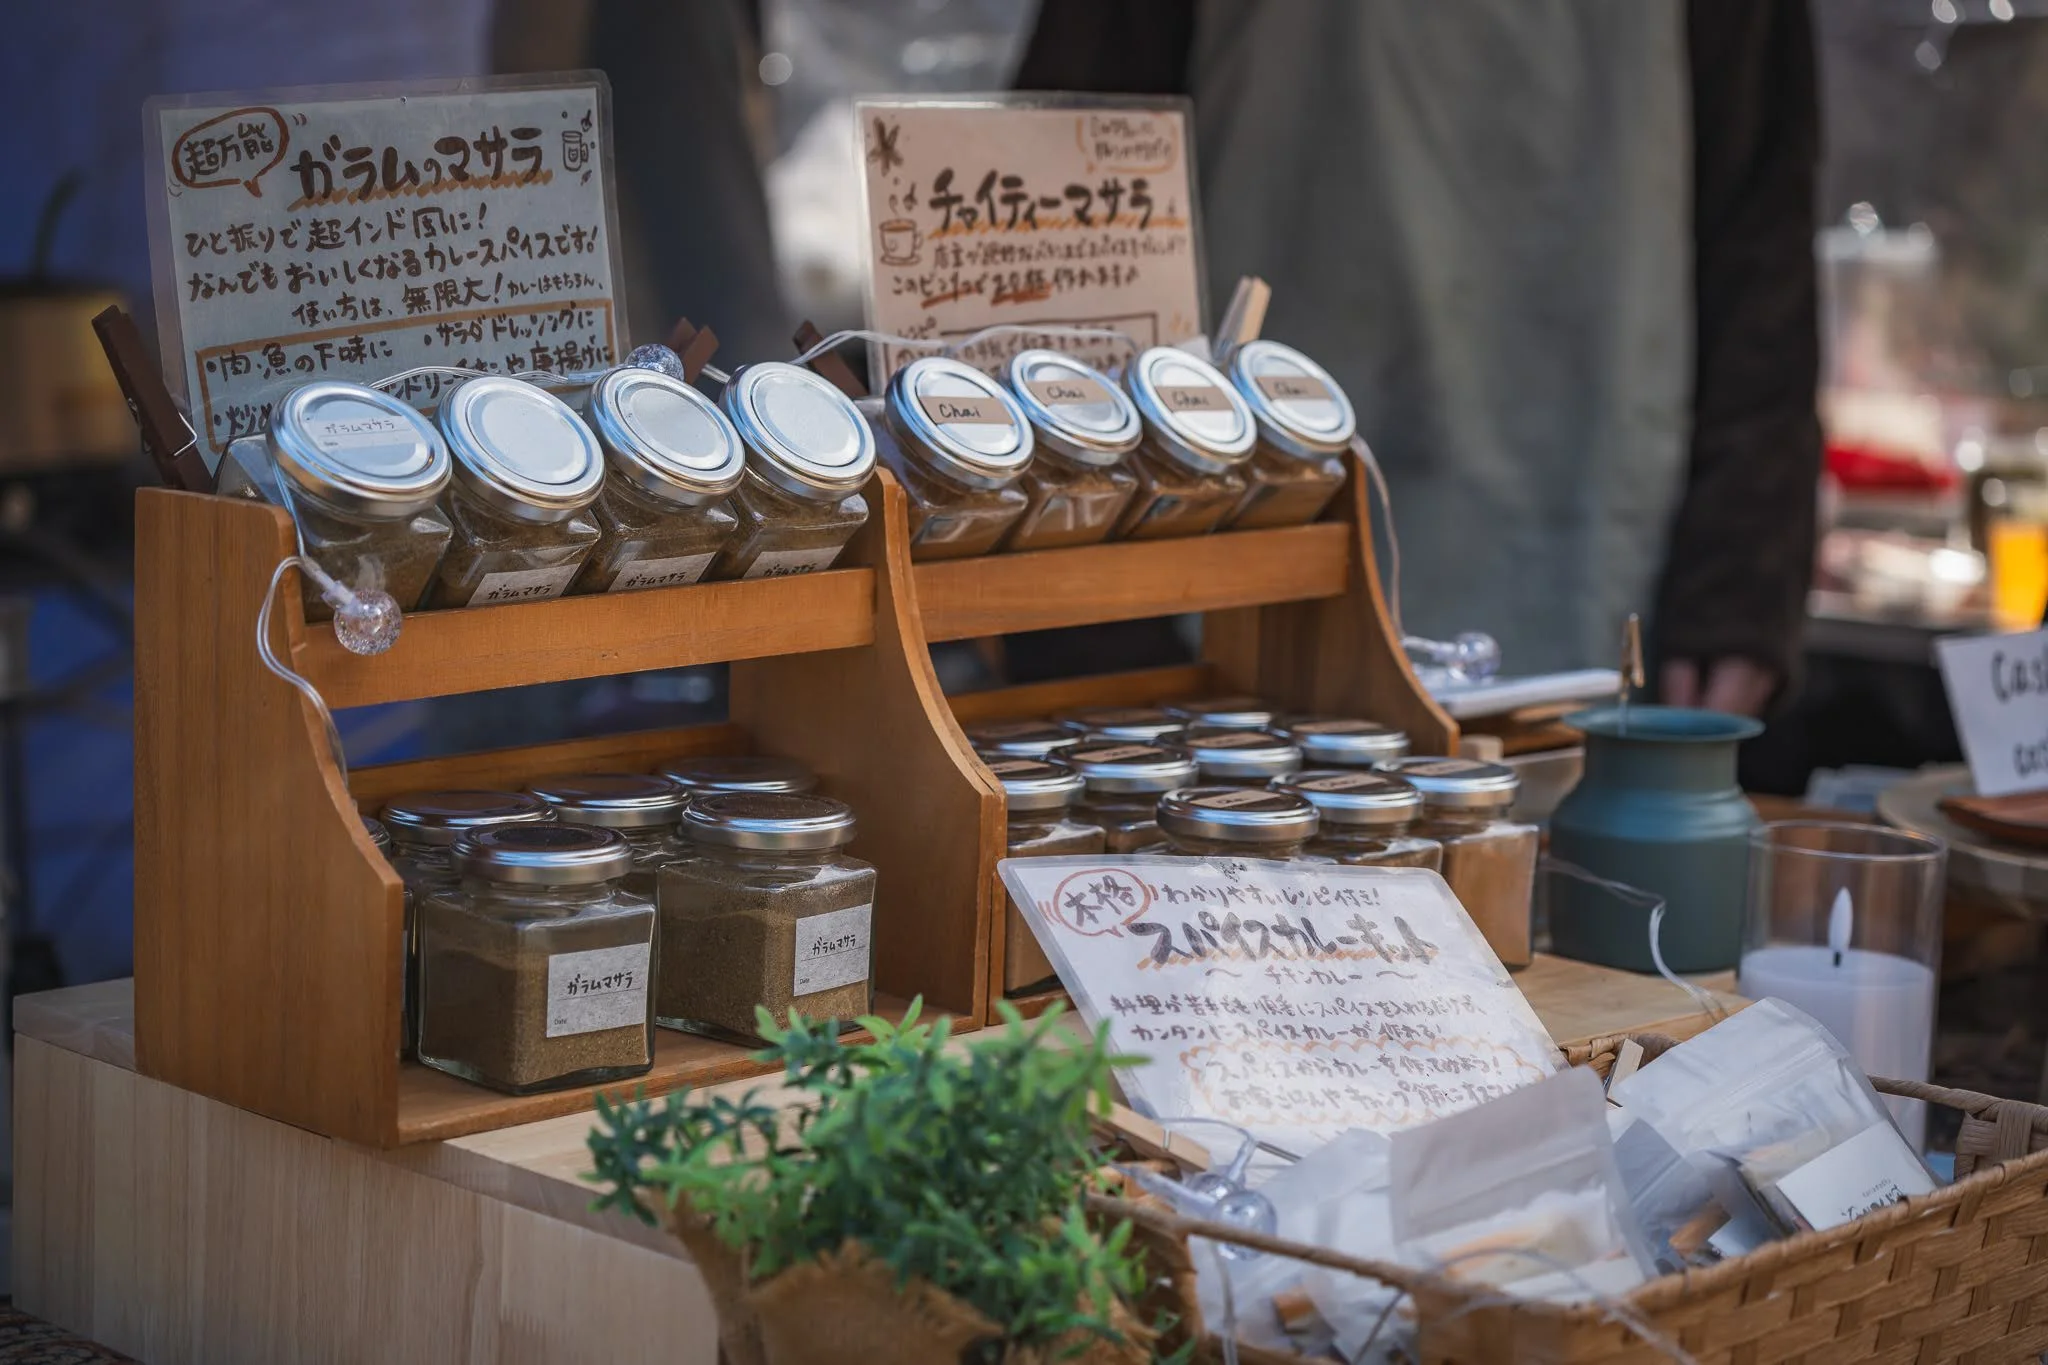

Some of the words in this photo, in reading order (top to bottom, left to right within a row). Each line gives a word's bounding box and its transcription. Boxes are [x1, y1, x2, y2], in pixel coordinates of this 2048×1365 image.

[184, 123, 274, 182] 超万能
[290, 126, 543, 200] ガラムのマサラ
[929, 168, 1154, 231] チャイティーマサラ
[1046, 385, 1085, 400] Chai
[939, 402, 981, 419] Chai
[325, 418, 395, 434] ガラムマサラ
[626, 571, 687, 588] ガラムマサラ
[488, 584, 552, 600] ガラムマサラ
[1064, 874, 1136, 926] 本格
[812, 934, 857, 956] ガラムマサラ
[1127, 911, 1440, 965] スパイスカレーキット
[567, 971, 633, 996] ガラムマサラ
